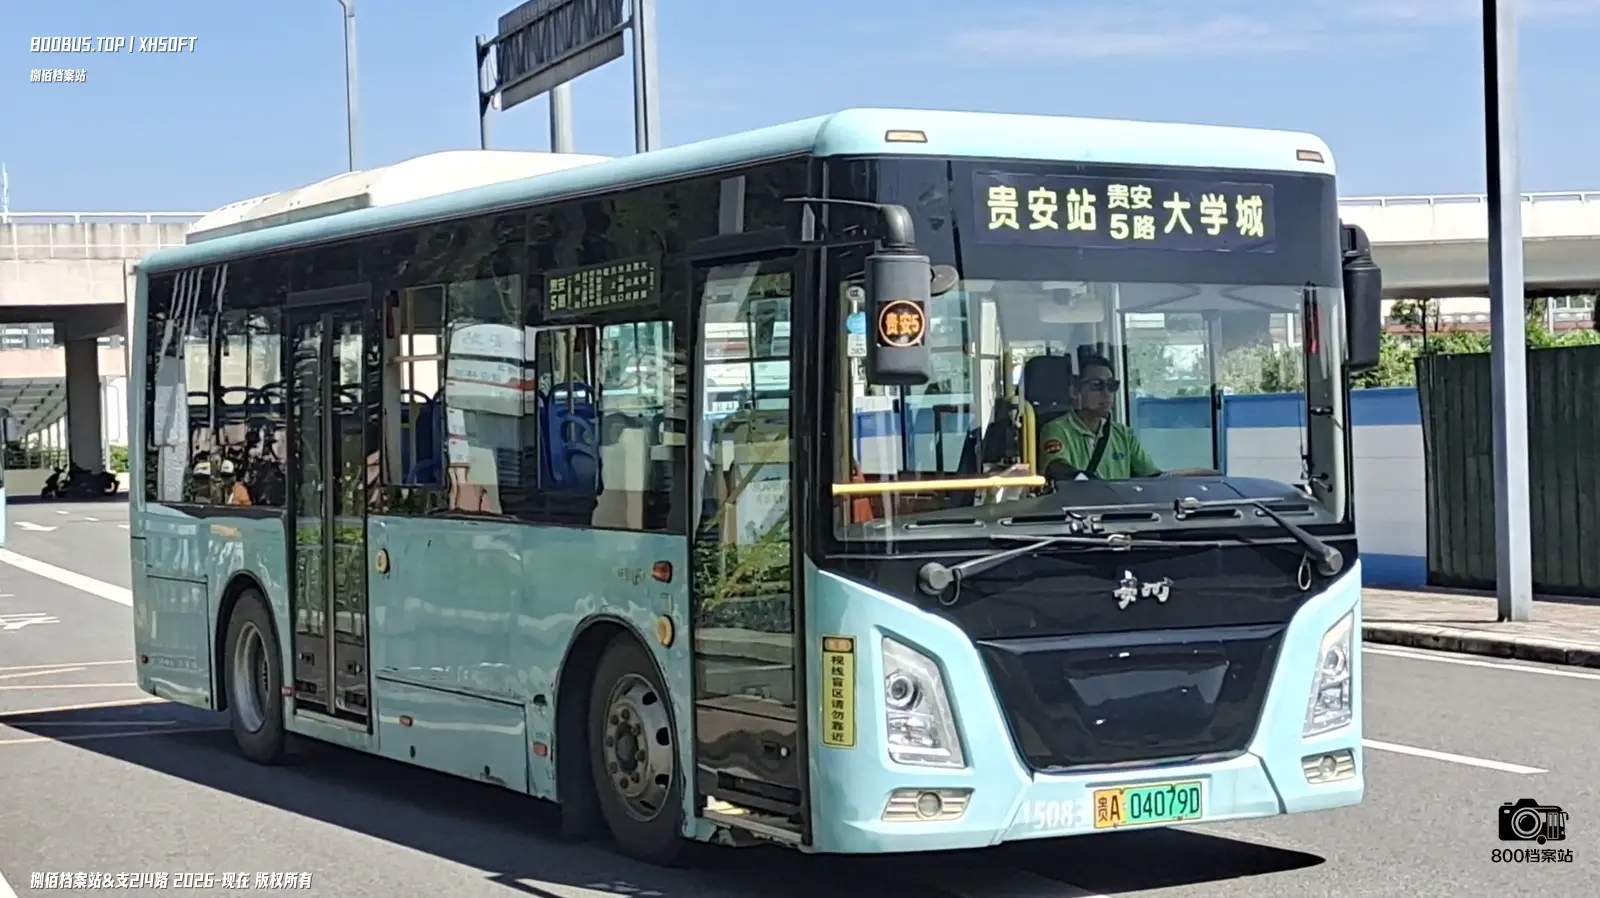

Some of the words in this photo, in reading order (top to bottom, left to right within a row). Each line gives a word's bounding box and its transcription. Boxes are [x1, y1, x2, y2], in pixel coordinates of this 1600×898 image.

[987, 185, 1098, 232] 贵安站
[1107, 183, 1153, 211] 贵安
[1163, 191, 1265, 238] 大学城
[1109, 213, 1156, 241] 5路
[830, 655, 846, 743] 视线盲区请勿靠近
